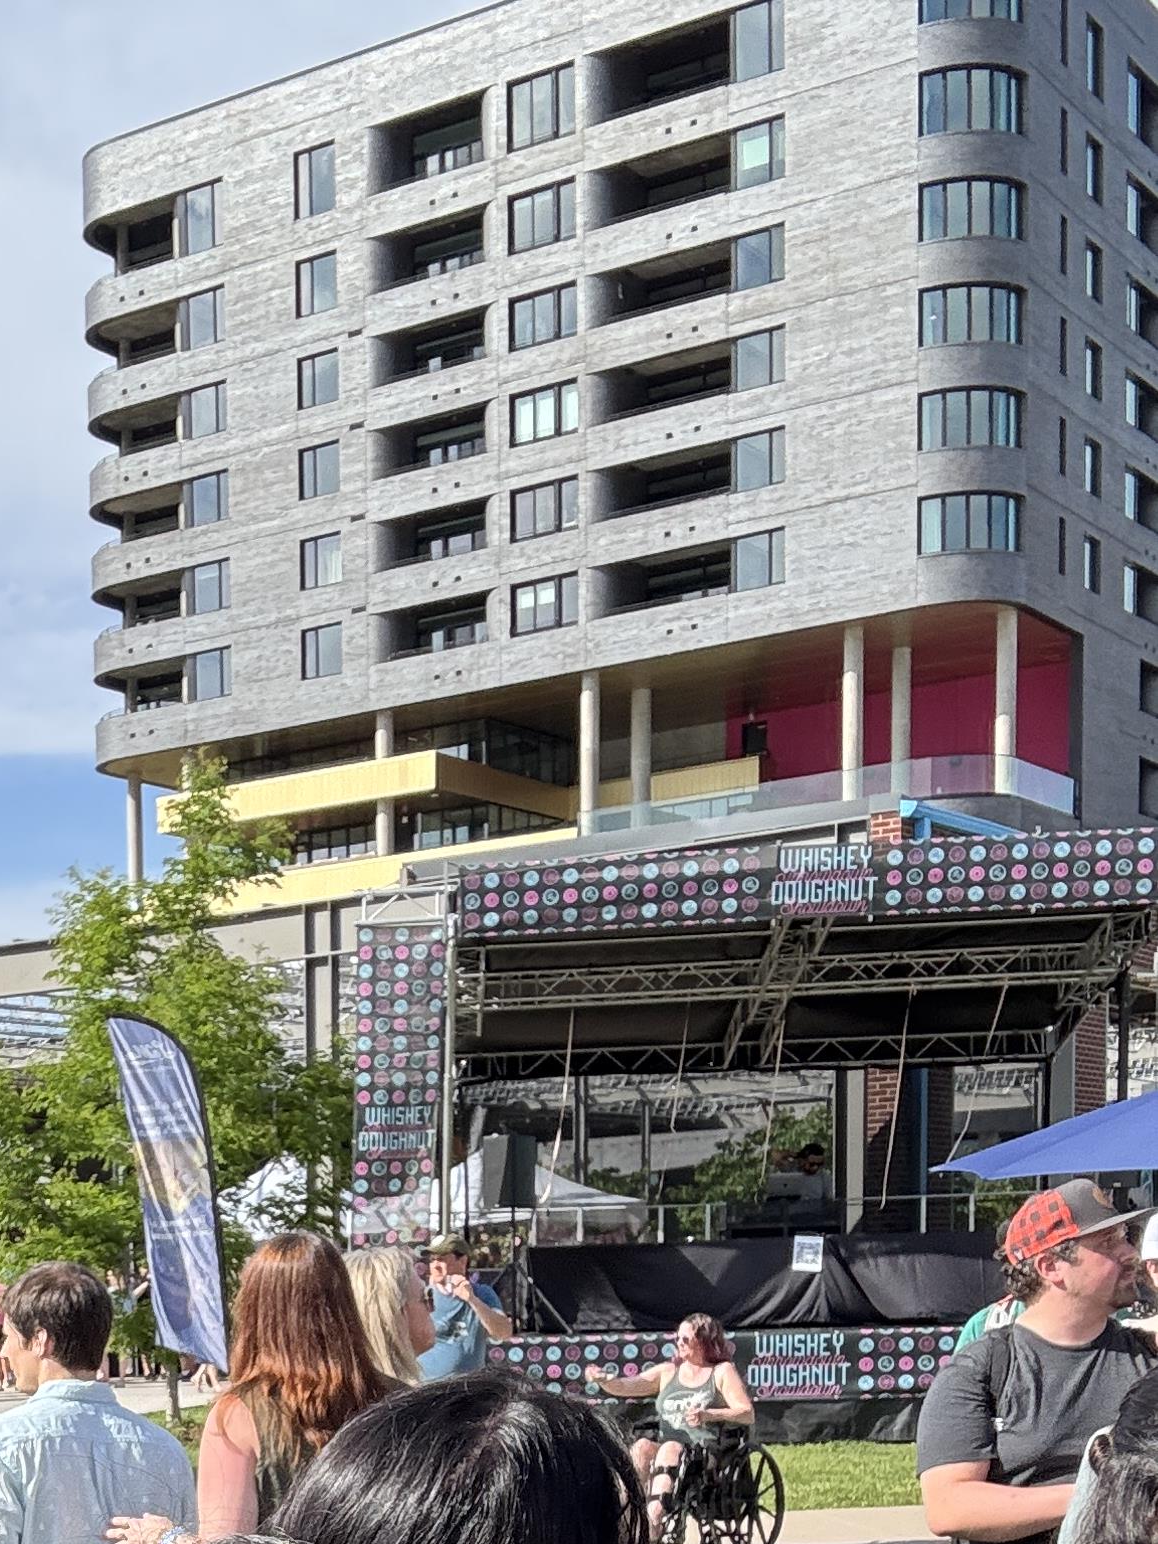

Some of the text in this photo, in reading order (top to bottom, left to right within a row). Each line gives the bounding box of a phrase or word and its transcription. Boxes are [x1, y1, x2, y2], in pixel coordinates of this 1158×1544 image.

[770, 876, 879, 906] DOUGHNUT
[358, 1129, 437, 1152] DOUGHNUT
[747, 1362, 852, 1388] DOUGHNUT
